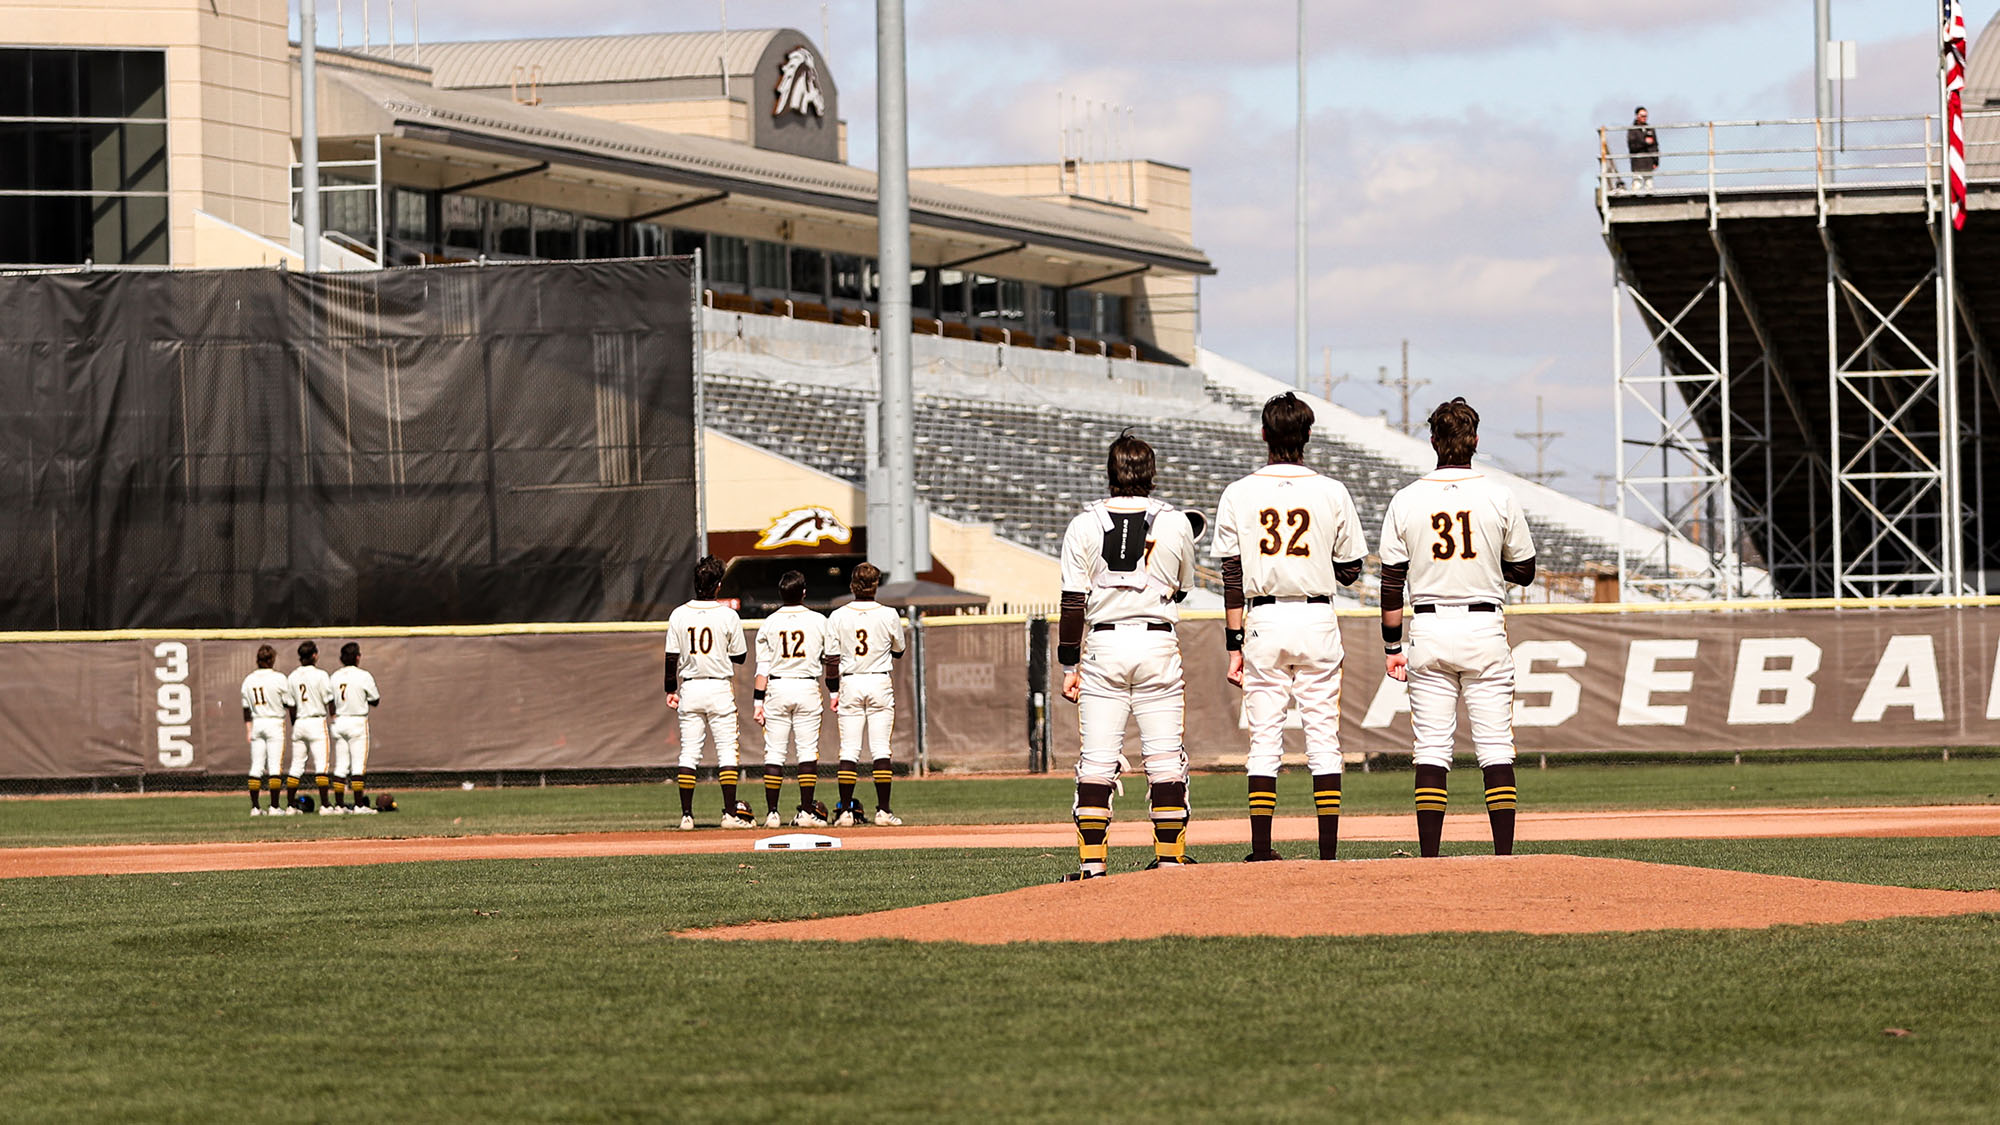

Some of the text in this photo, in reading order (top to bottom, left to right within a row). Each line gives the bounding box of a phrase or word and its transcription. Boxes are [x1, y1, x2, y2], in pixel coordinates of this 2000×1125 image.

[1259, 508, 1311, 557] 32
[1430, 509, 1477, 561] 31
[686, 626, 714, 655] 10
[778, 630, 806, 658] 12
[854, 629, 869, 657] 3
[299, 683, 308, 702] 2
[339, 683, 348, 702] 7
[1238, 633, 2000, 730] SEBA
[154, 642, 194, 768] 395
[252, 686, 267, 706] 11
